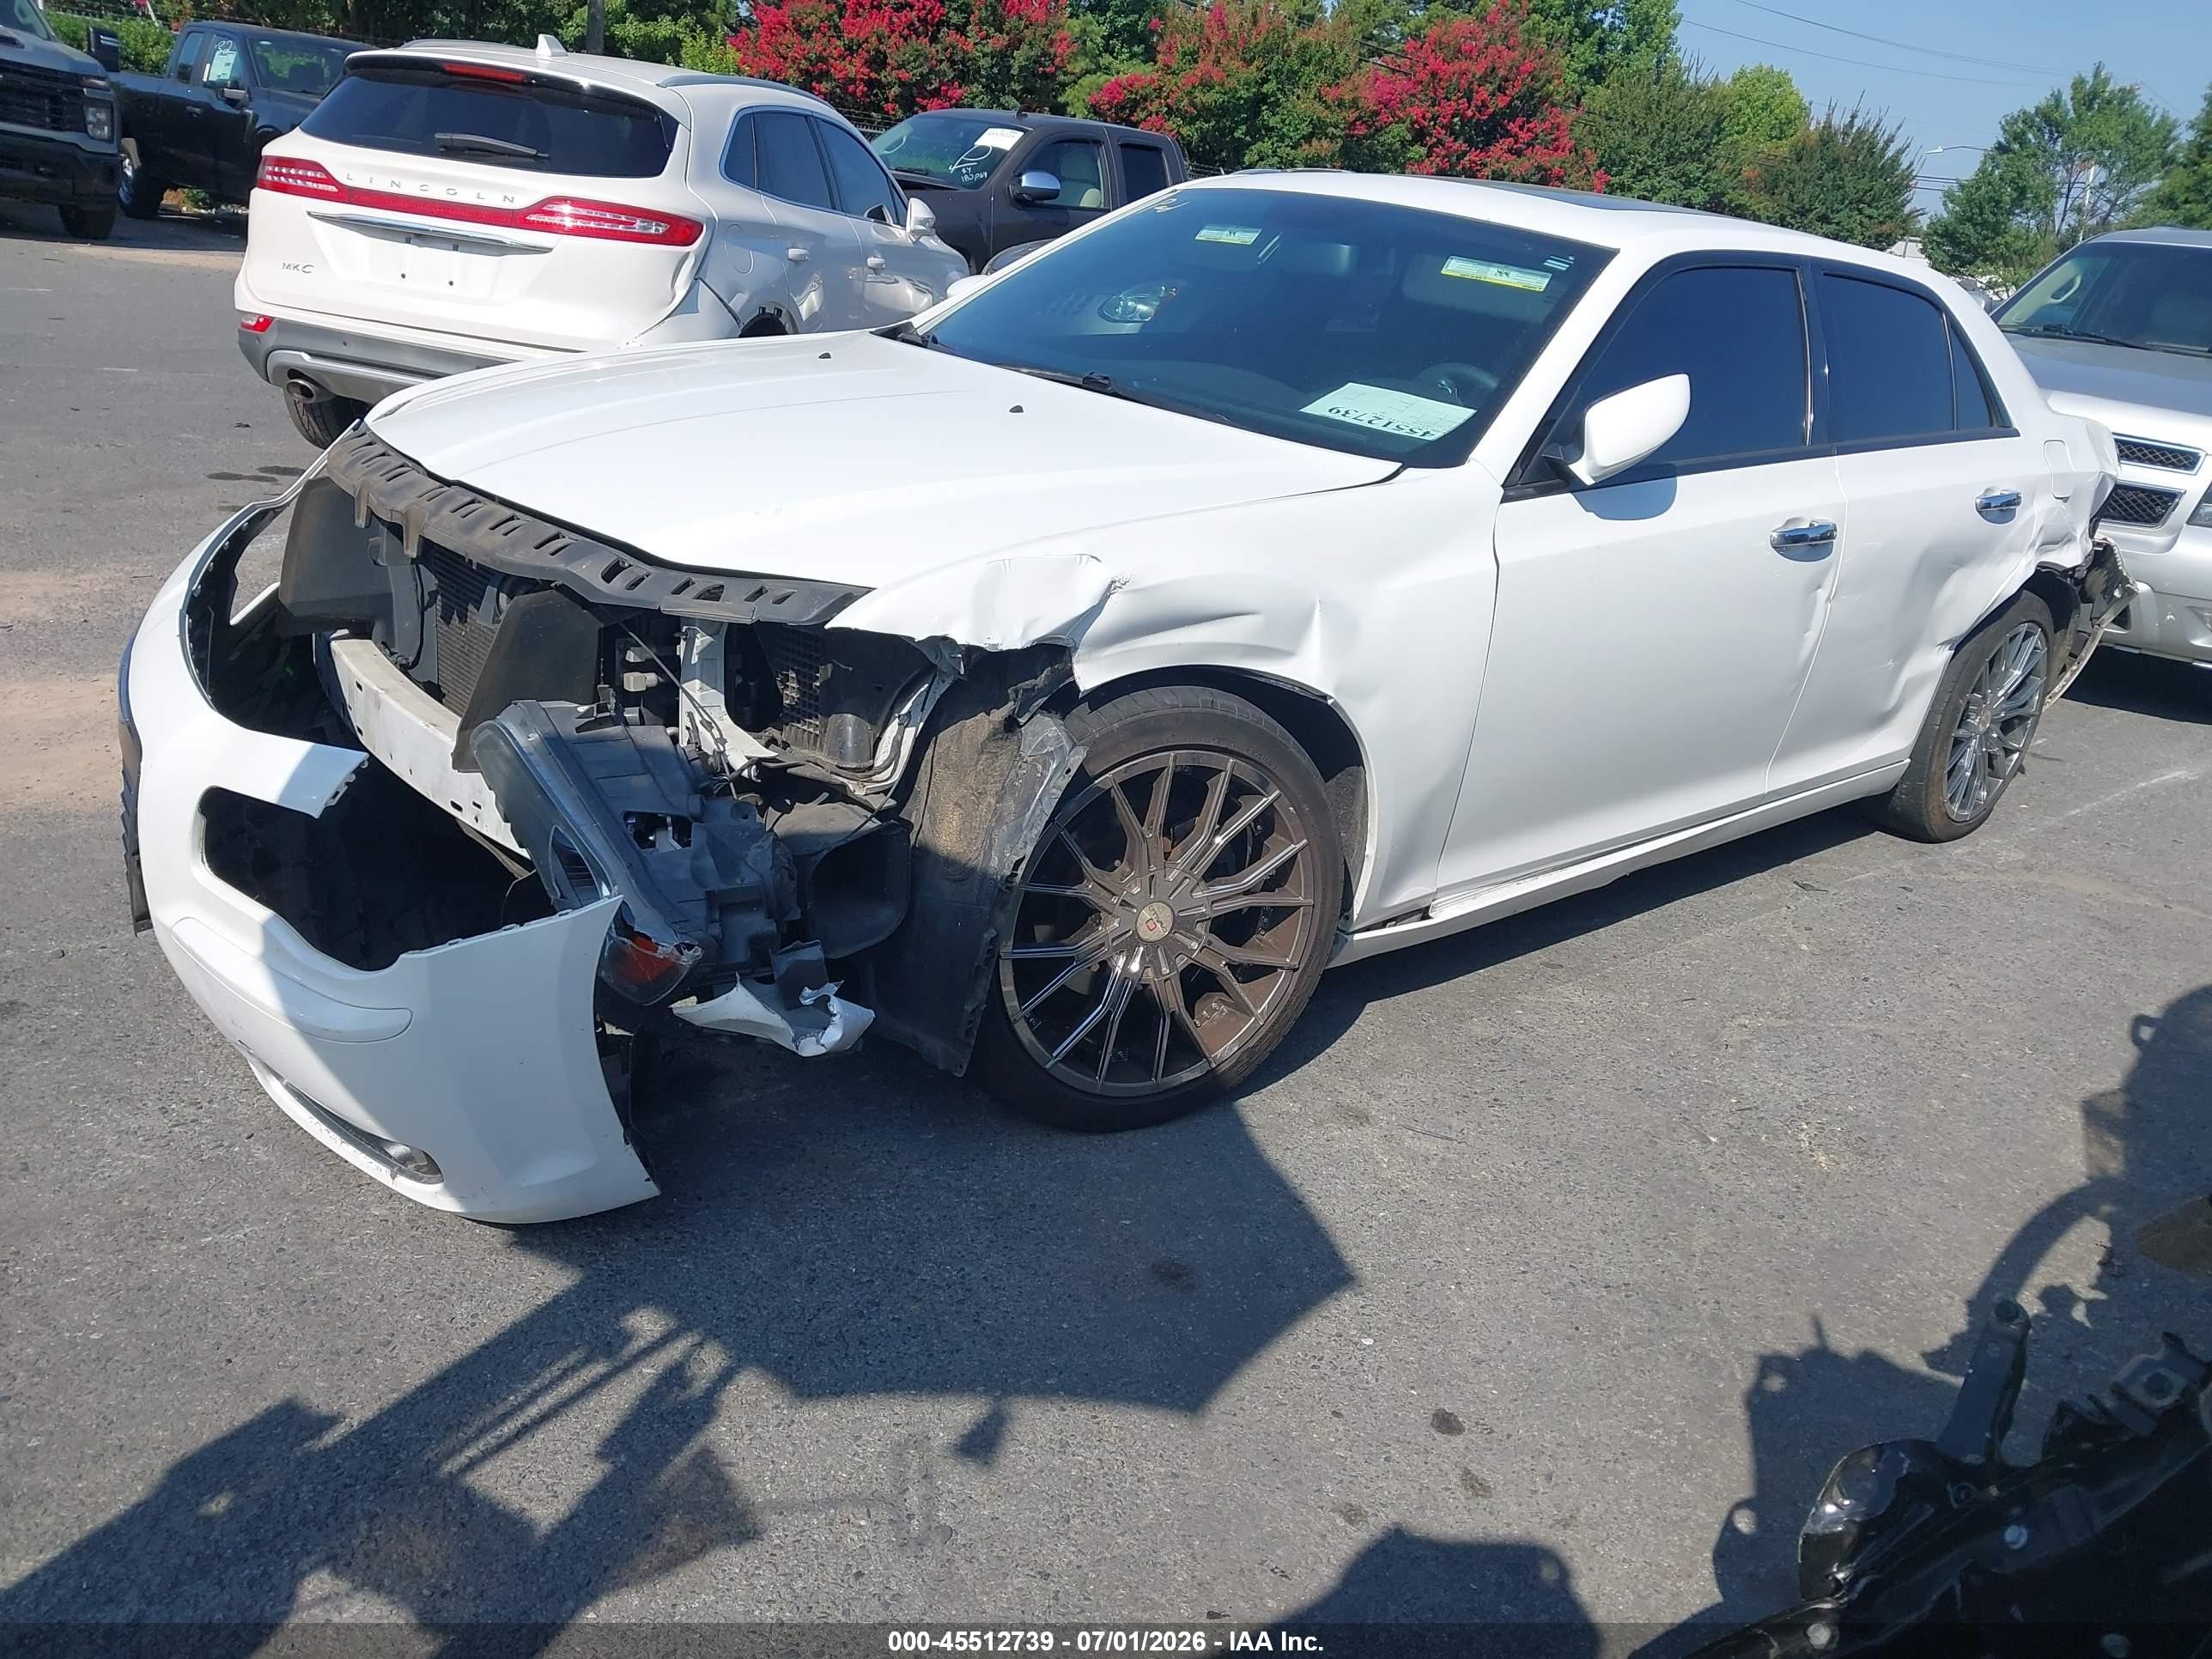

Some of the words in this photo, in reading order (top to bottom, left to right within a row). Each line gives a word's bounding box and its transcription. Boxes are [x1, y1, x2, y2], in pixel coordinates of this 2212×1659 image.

[346, 173, 515, 204] LINCOLN
[282, 262, 315, 274] MKC
[1328, 406, 1436, 438] 45512739
